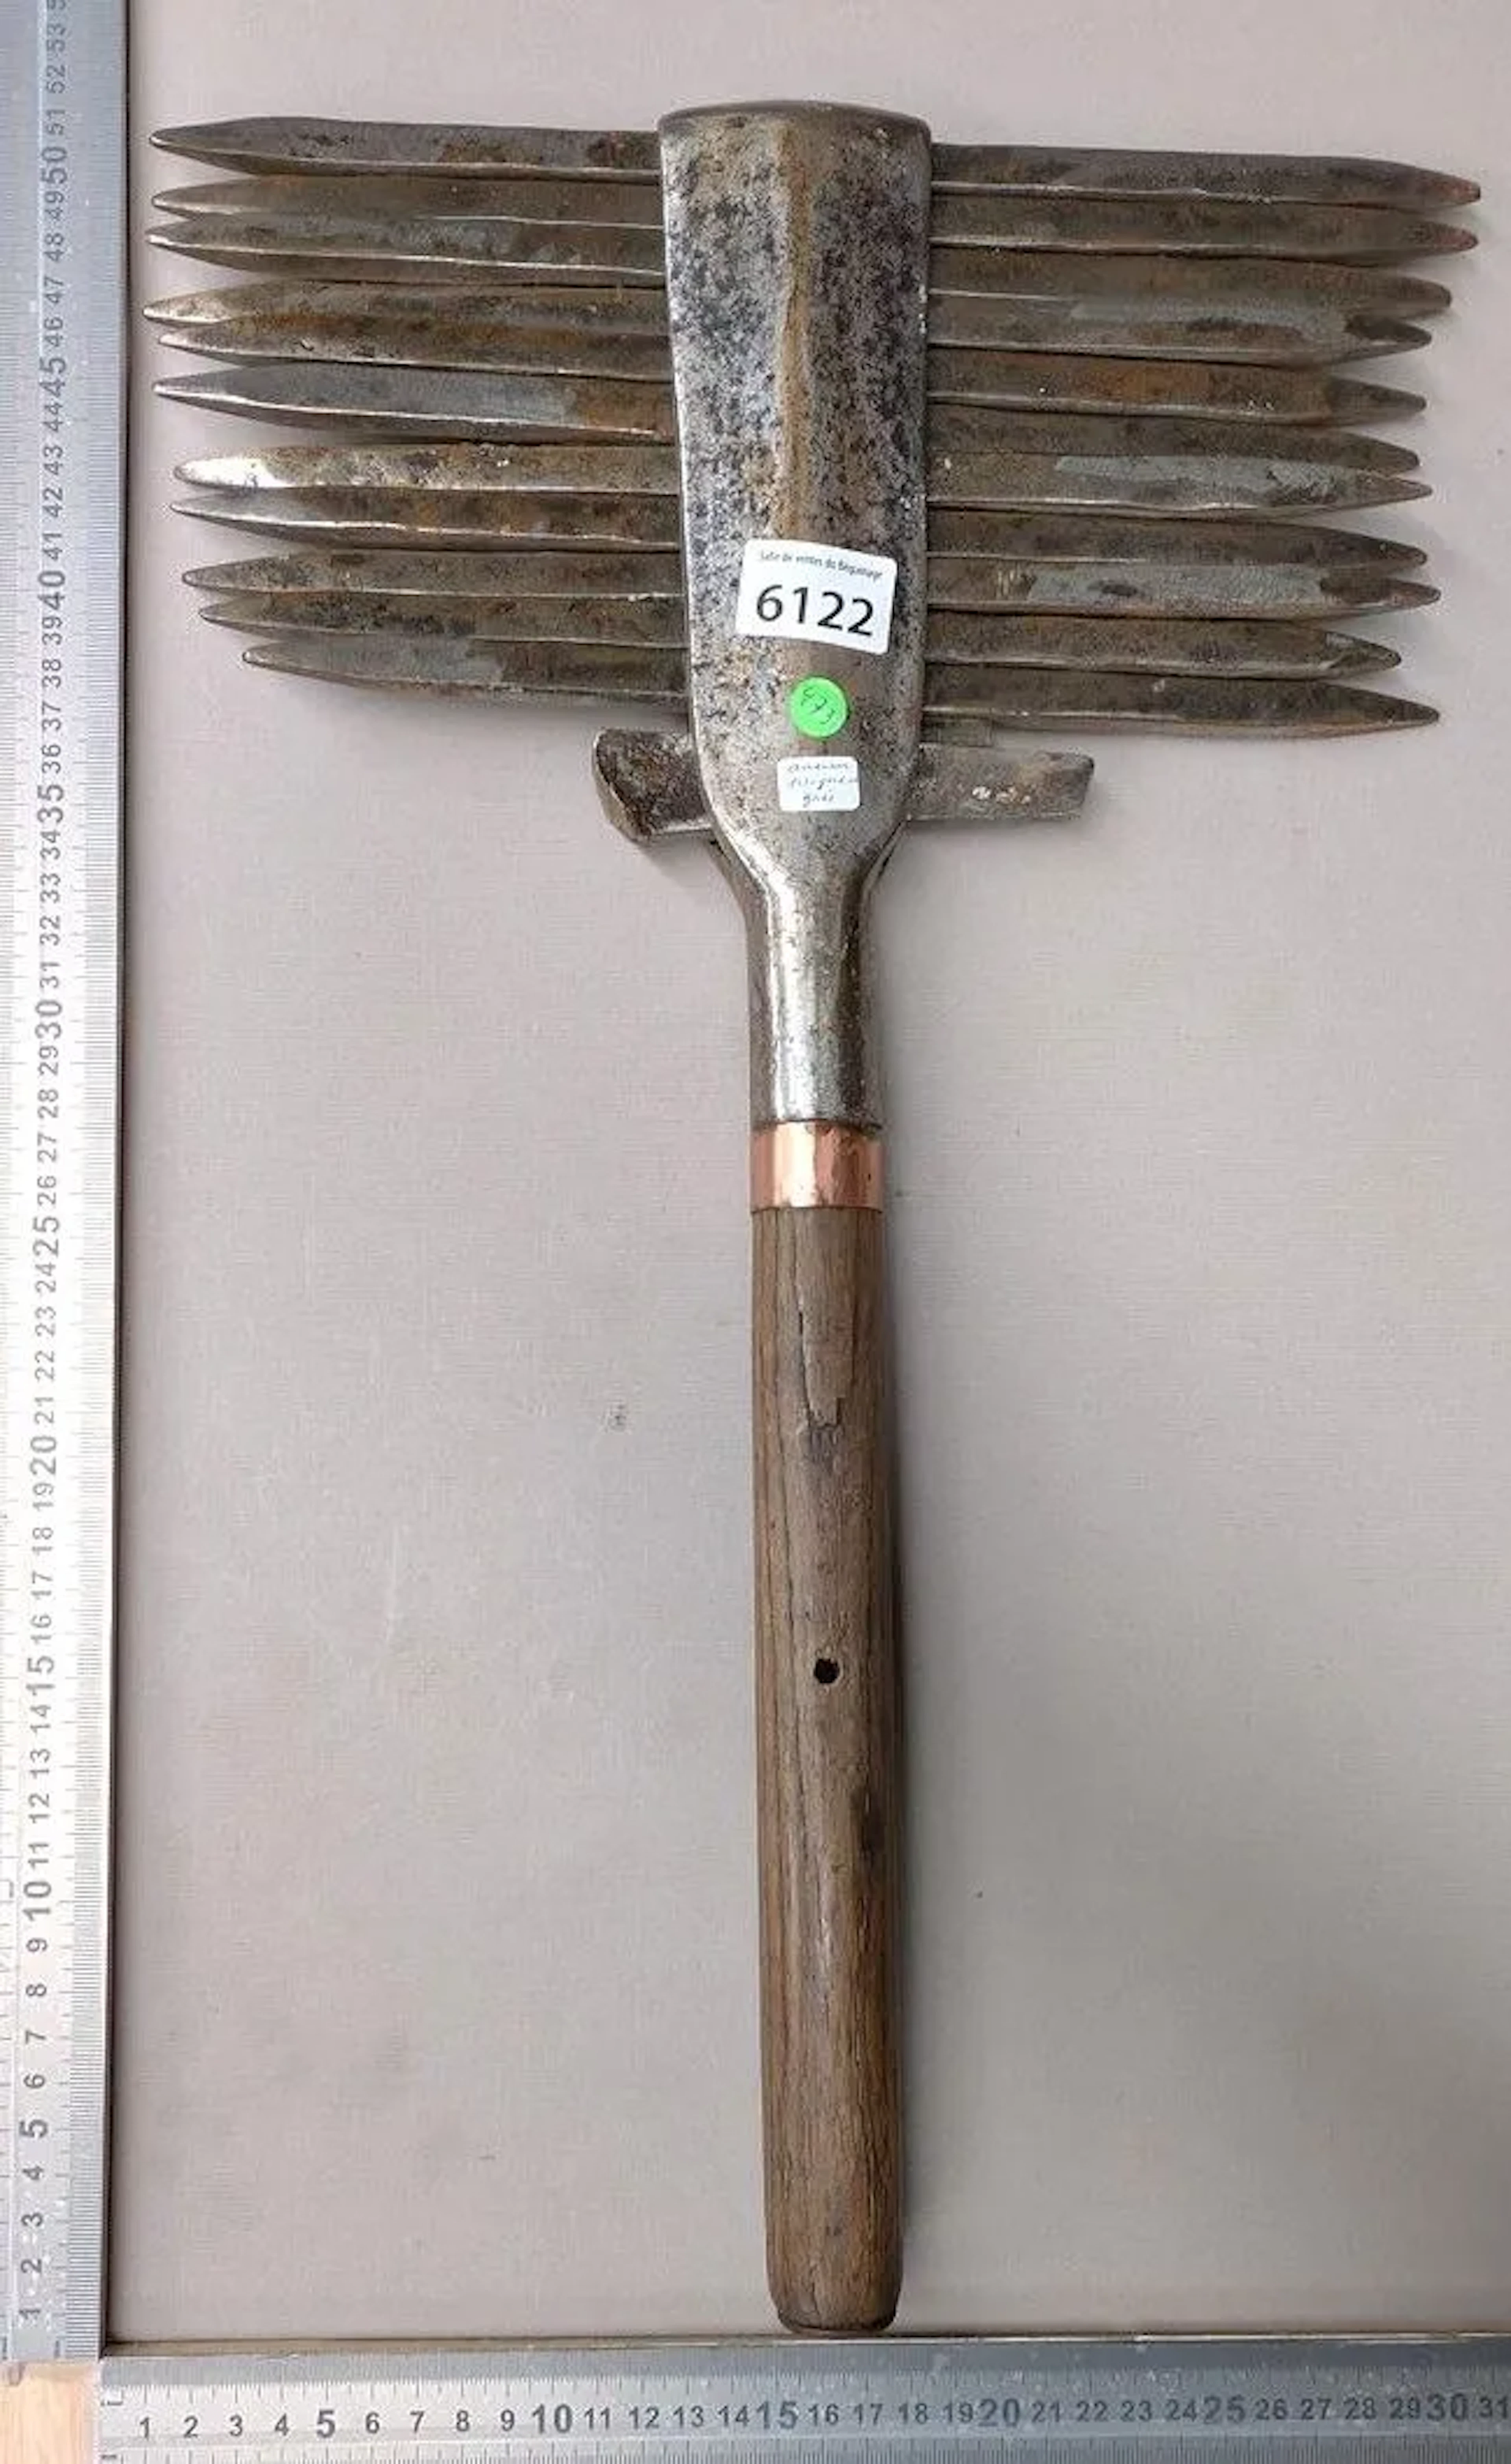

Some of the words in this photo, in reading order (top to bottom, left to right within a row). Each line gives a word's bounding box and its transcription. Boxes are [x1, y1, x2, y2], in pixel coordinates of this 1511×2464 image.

[46, 24, 66, 52] 53
[46, 65, 65, 94] 52
[46, 109, 65, 135] 51
[41, 146, 67, 184] 50
[44, 191, 64, 221] 49
[44, 233, 64, 262] 48
[44, 277, 64, 304] 47
[44, 317, 63, 347] 46
[40, 357, 66, 397] 45
[44, 403, 63, 432] 44
[44, 445, 63, 475] 43
[42, 487, 63, 517] 42
[42, 533, 62, 561] 41
[38, 571, 65, 610] 40
[756, 584, 873, 636] 6122
[42, 616, 62, 645] 39
[42, 659, 61, 688] 38
[42, 703, 61, 731] 37
[42, 744, 61, 774] 36
[37, 785, 64, 823] 35
[41, 831, 60, 860] 34
[40, 873, 60, 903] 33
[40, 916, 60, 945] 32
[40, 961, 59, 988] 31
[35, 1000, 62, 1039] 30
[38, 1046, 58, 1076] 29
[38, 1089, 58, 1118] 28
[37, 1133, 57, 1162] 27
[37, 1176, 56, 1206] 26
[32, 1216, 60, 1257] 25
[35, 1262, 56, 1293] 24
[35, 1306, 56, 1336] 23
[35, 1350, 54, 1382] 22
[34, 1397, 54, 1424] 21
[30, 1436, 57, 1475] 20
[32, 1483, 54, 1511] 19
[32, 1528, 53, 1555] 18
[31, 1571, 53, 1599] 17
[30, 1615, 52, 1644] 16
[26, 1656, 55, 1695] 15
[30, 1704, 51, 1733] 14
[28, 1749, 50, 1778] 13
[28, 1793, 50, 1823] 12
[28, 1842, 50, 1868] 11
[23, 1881, 52, 1921] 10
[26, 1938, 47, 1952] 9
[26, 1983, 46, 1997] 8
[26, 2030, 46, 2044] 7
[24, 2074, 46, 2089] 6
[19, 2120, 48, 2138] 5
[23, 2166, 44, 2181] 4
[21, 2212, 44, 2228] 3
[21, 2259, 42, 2274] 2
[20, 2309, 41, 2320] 1
[140, 2417, 150, 2439] 1
[184, 2416, 198, 2438] 2
[229, 2416, 243, 2437] 3
[275, 2414, 289, 2436] 4
[317, 2410, 335, 2438] 5
[365, 2413, 379, 2434] 6
[410, 2411, 425, 2433] 7
[456, 2411, 470, 2432] 8
[500, 2410, 515, 2431] 9
[533, 2403, 573, 2434] 10
[584, 2407, 611, 2430] 11
[630, 2407, 659, 2429] 12
[673, 2406, 704, 2427] 13
[719, 2405, 749, 2427] 14
[757, 2401, 798, 2430] 15
[809, 2404, 839, 2426] 16
[855, 2403, 883, 2425] 17
[899, 2403, 928, 2425] 18
[944, 2403, 973, 2423] 19
[978, 2399, 1020, 2427] 20
[1033, 2401, 1061, 2422] 21
[1076, 2400, 1107, 2422] 22
[1122, 2400, 1152, 2421] 23
[1167, 2399, 1197, 2420] 24
[1204, 2396, 1245, 2423] 25
[1256, 2398, 1287, 2419] 26
[1301, 2398, 1331, 2419] 27
[1344, 2397, 1377, 2419] 28
[1390, 2397, 1420, 2419] 29
[1427, 2394, 1467, 2420] 30
[1479, 2397, 1509, 2418] 31
